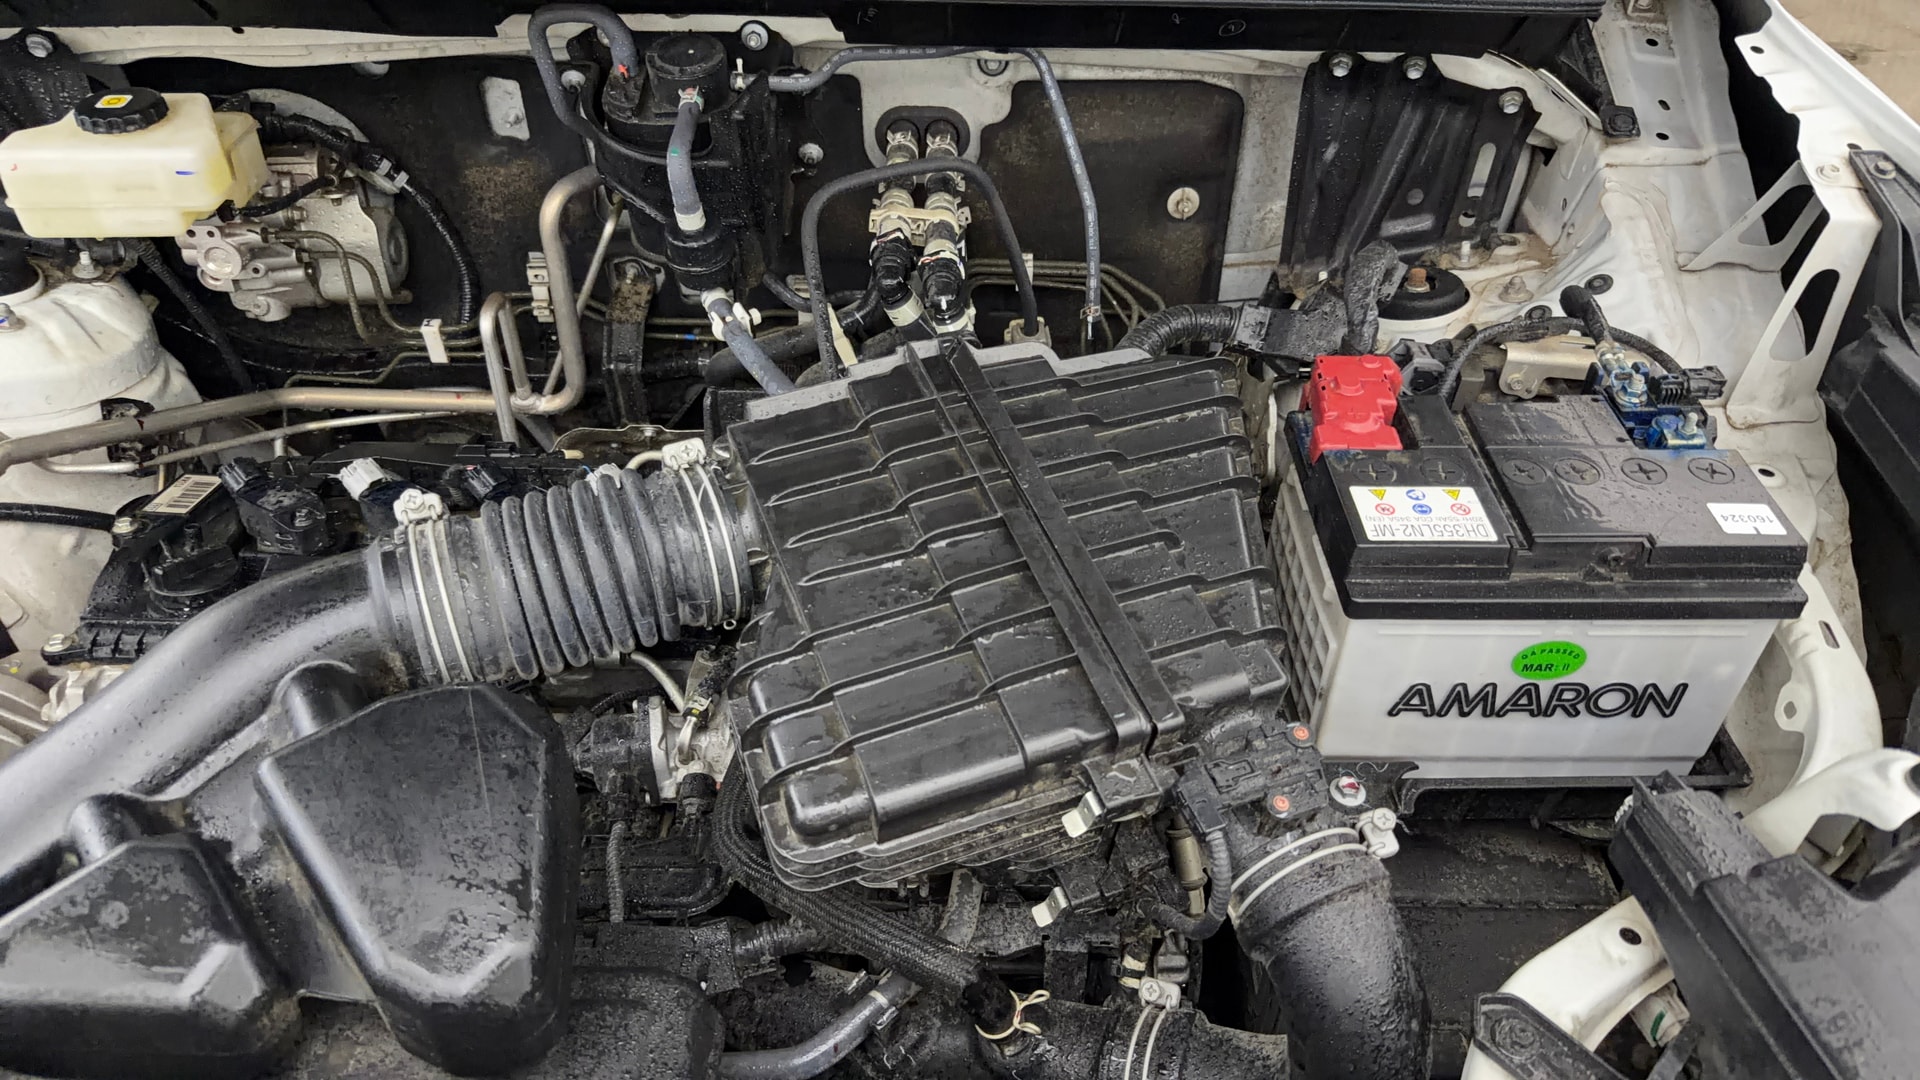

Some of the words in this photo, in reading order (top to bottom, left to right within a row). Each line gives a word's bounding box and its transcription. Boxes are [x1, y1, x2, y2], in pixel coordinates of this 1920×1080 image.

[1720, 514, 1774, 523] 160324
[1371, 524, 1489, 537] DH355LN2-MF
[1540, 648, 1580, 659] PASSED
[1387, 682, 1689, 718] AMARON
